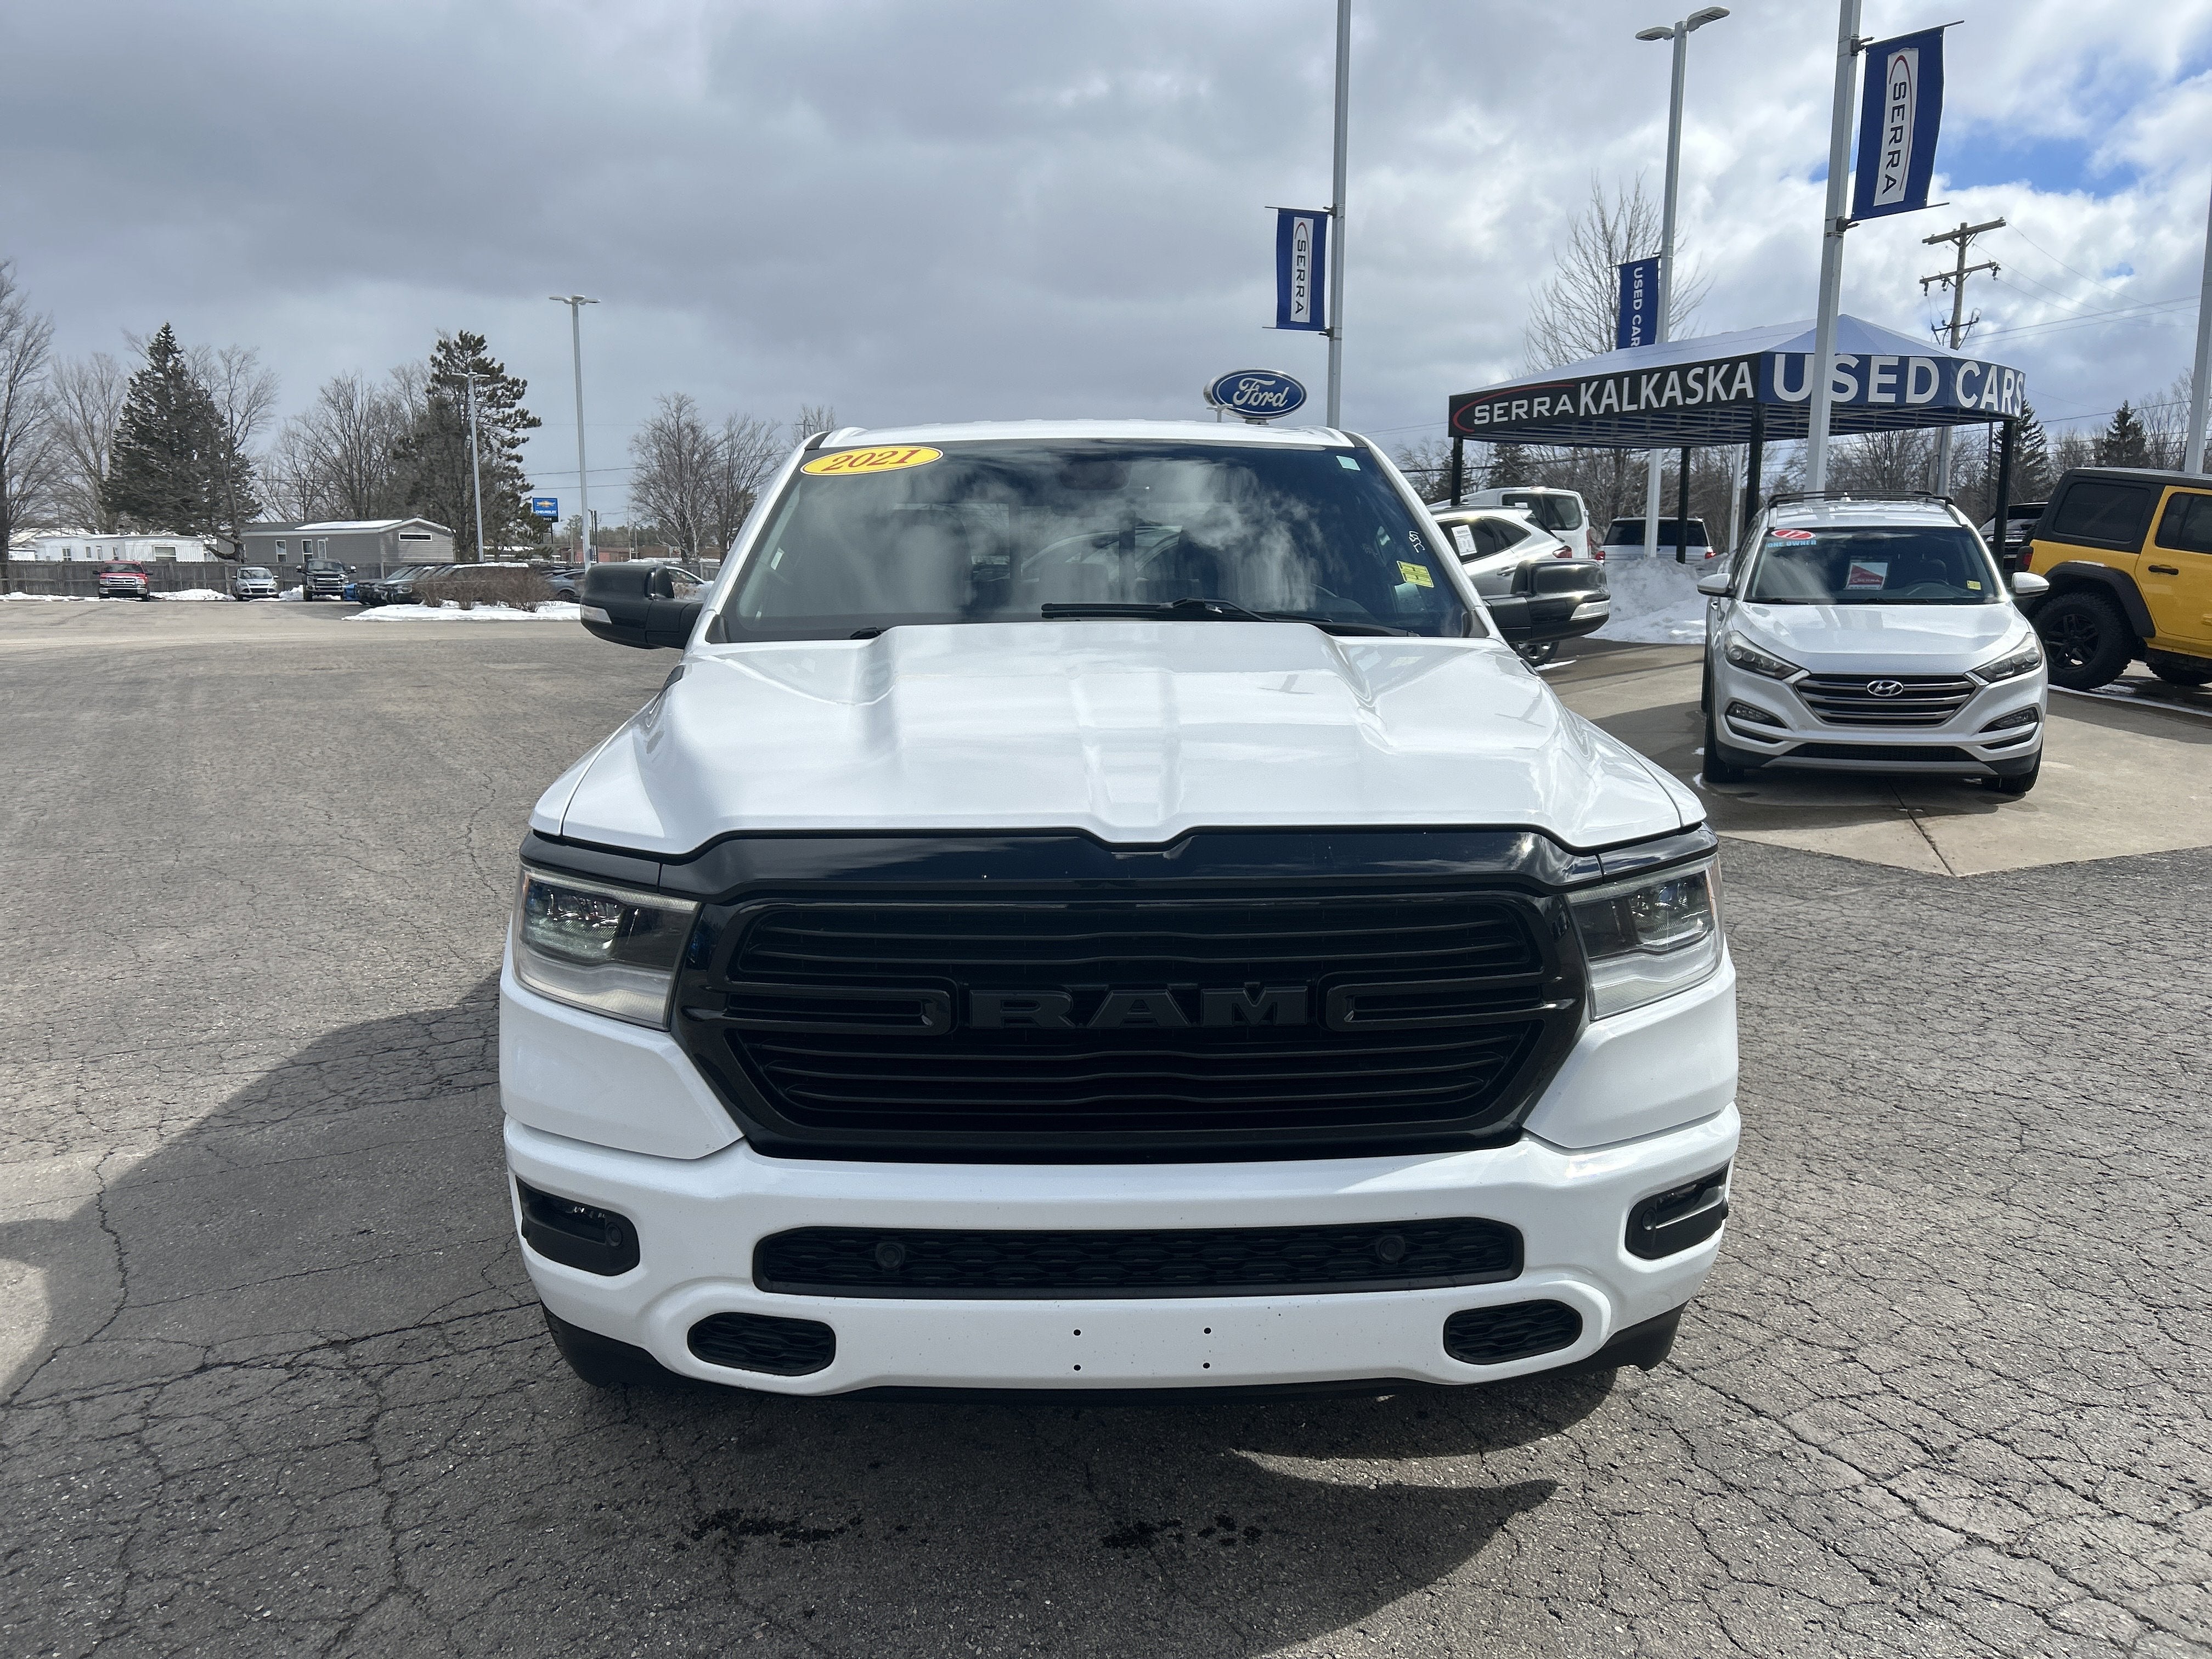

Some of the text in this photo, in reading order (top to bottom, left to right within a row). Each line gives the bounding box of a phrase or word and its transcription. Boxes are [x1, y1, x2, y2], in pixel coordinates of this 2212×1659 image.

[1882, 81, 1908, 195] SERRA
[1295, 239, 1307, 315] SERRA
[1633, 266, 1644, 311] USED
[1232, 377, 1289, 408] Ford
[1473, 361, 1754, 425] SERRA KALKASKA
[1773, 354, 2024, 417] USED CARS
[820, 449, 922, 472] 2021
[969, 985, 1308, 1029] RAM
